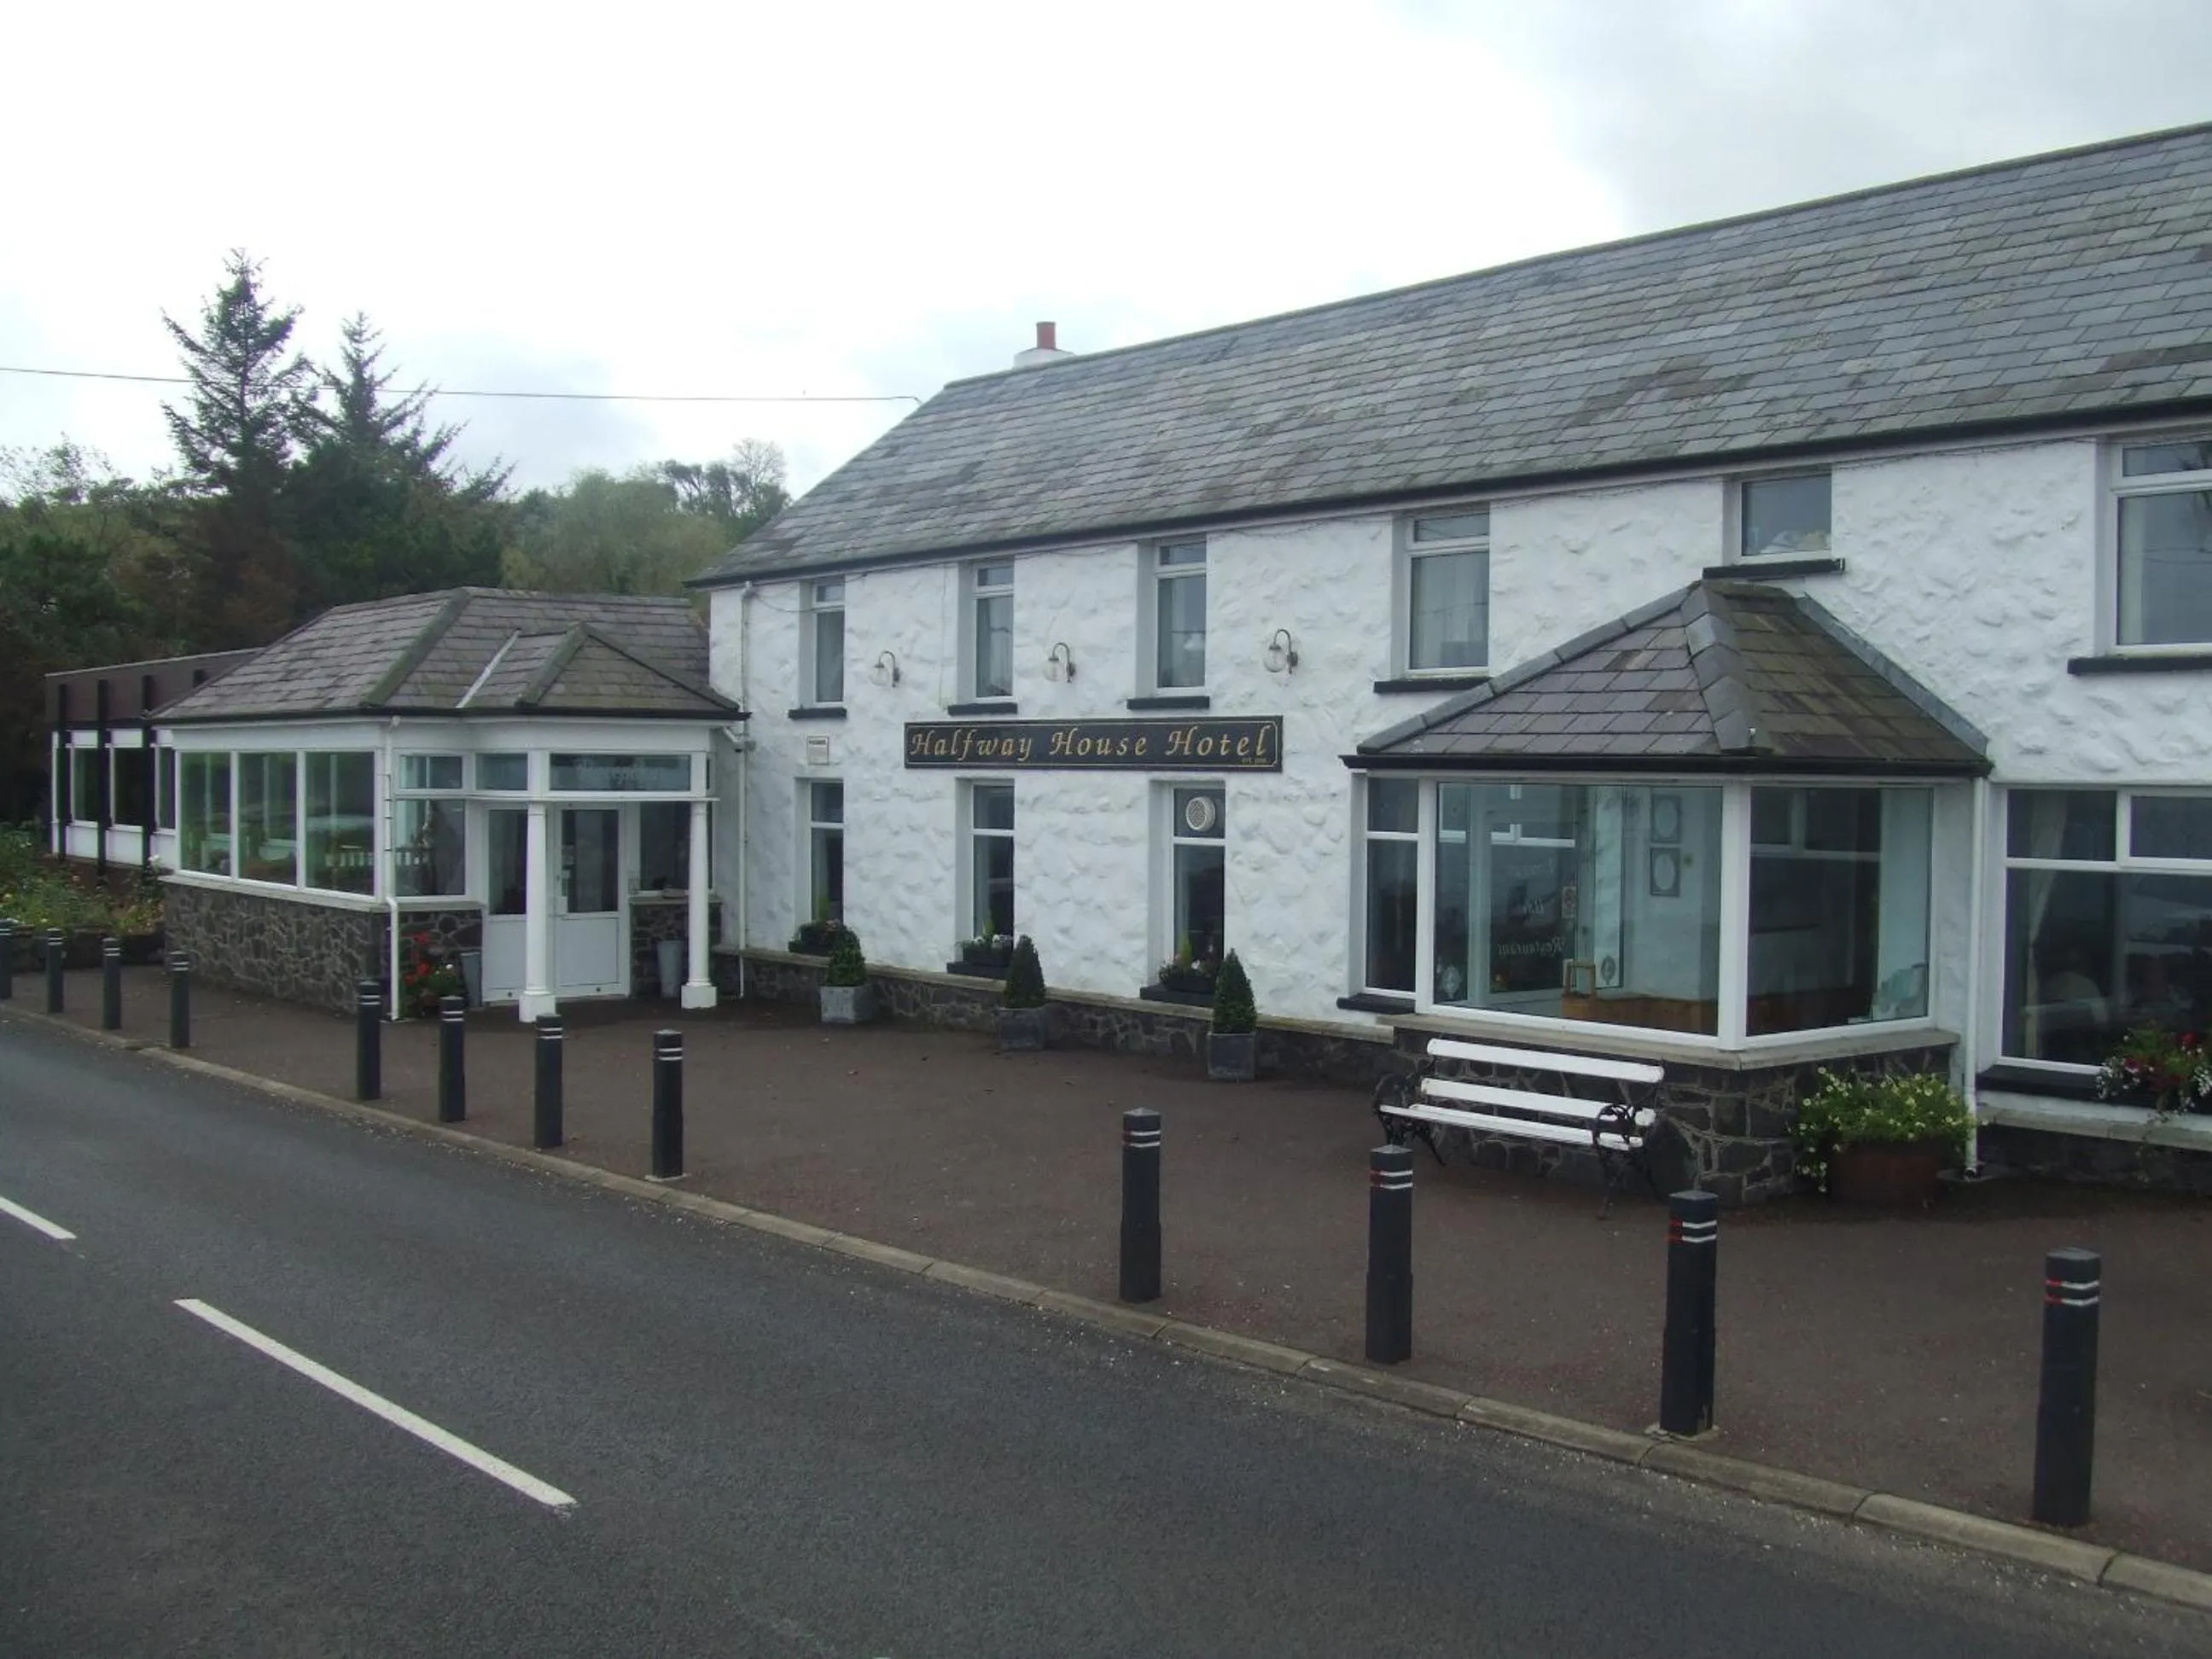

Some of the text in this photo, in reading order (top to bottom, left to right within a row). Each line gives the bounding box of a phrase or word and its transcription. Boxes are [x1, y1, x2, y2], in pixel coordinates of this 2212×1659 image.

[910, 725, 1271, 761] Halfway House Hotel
